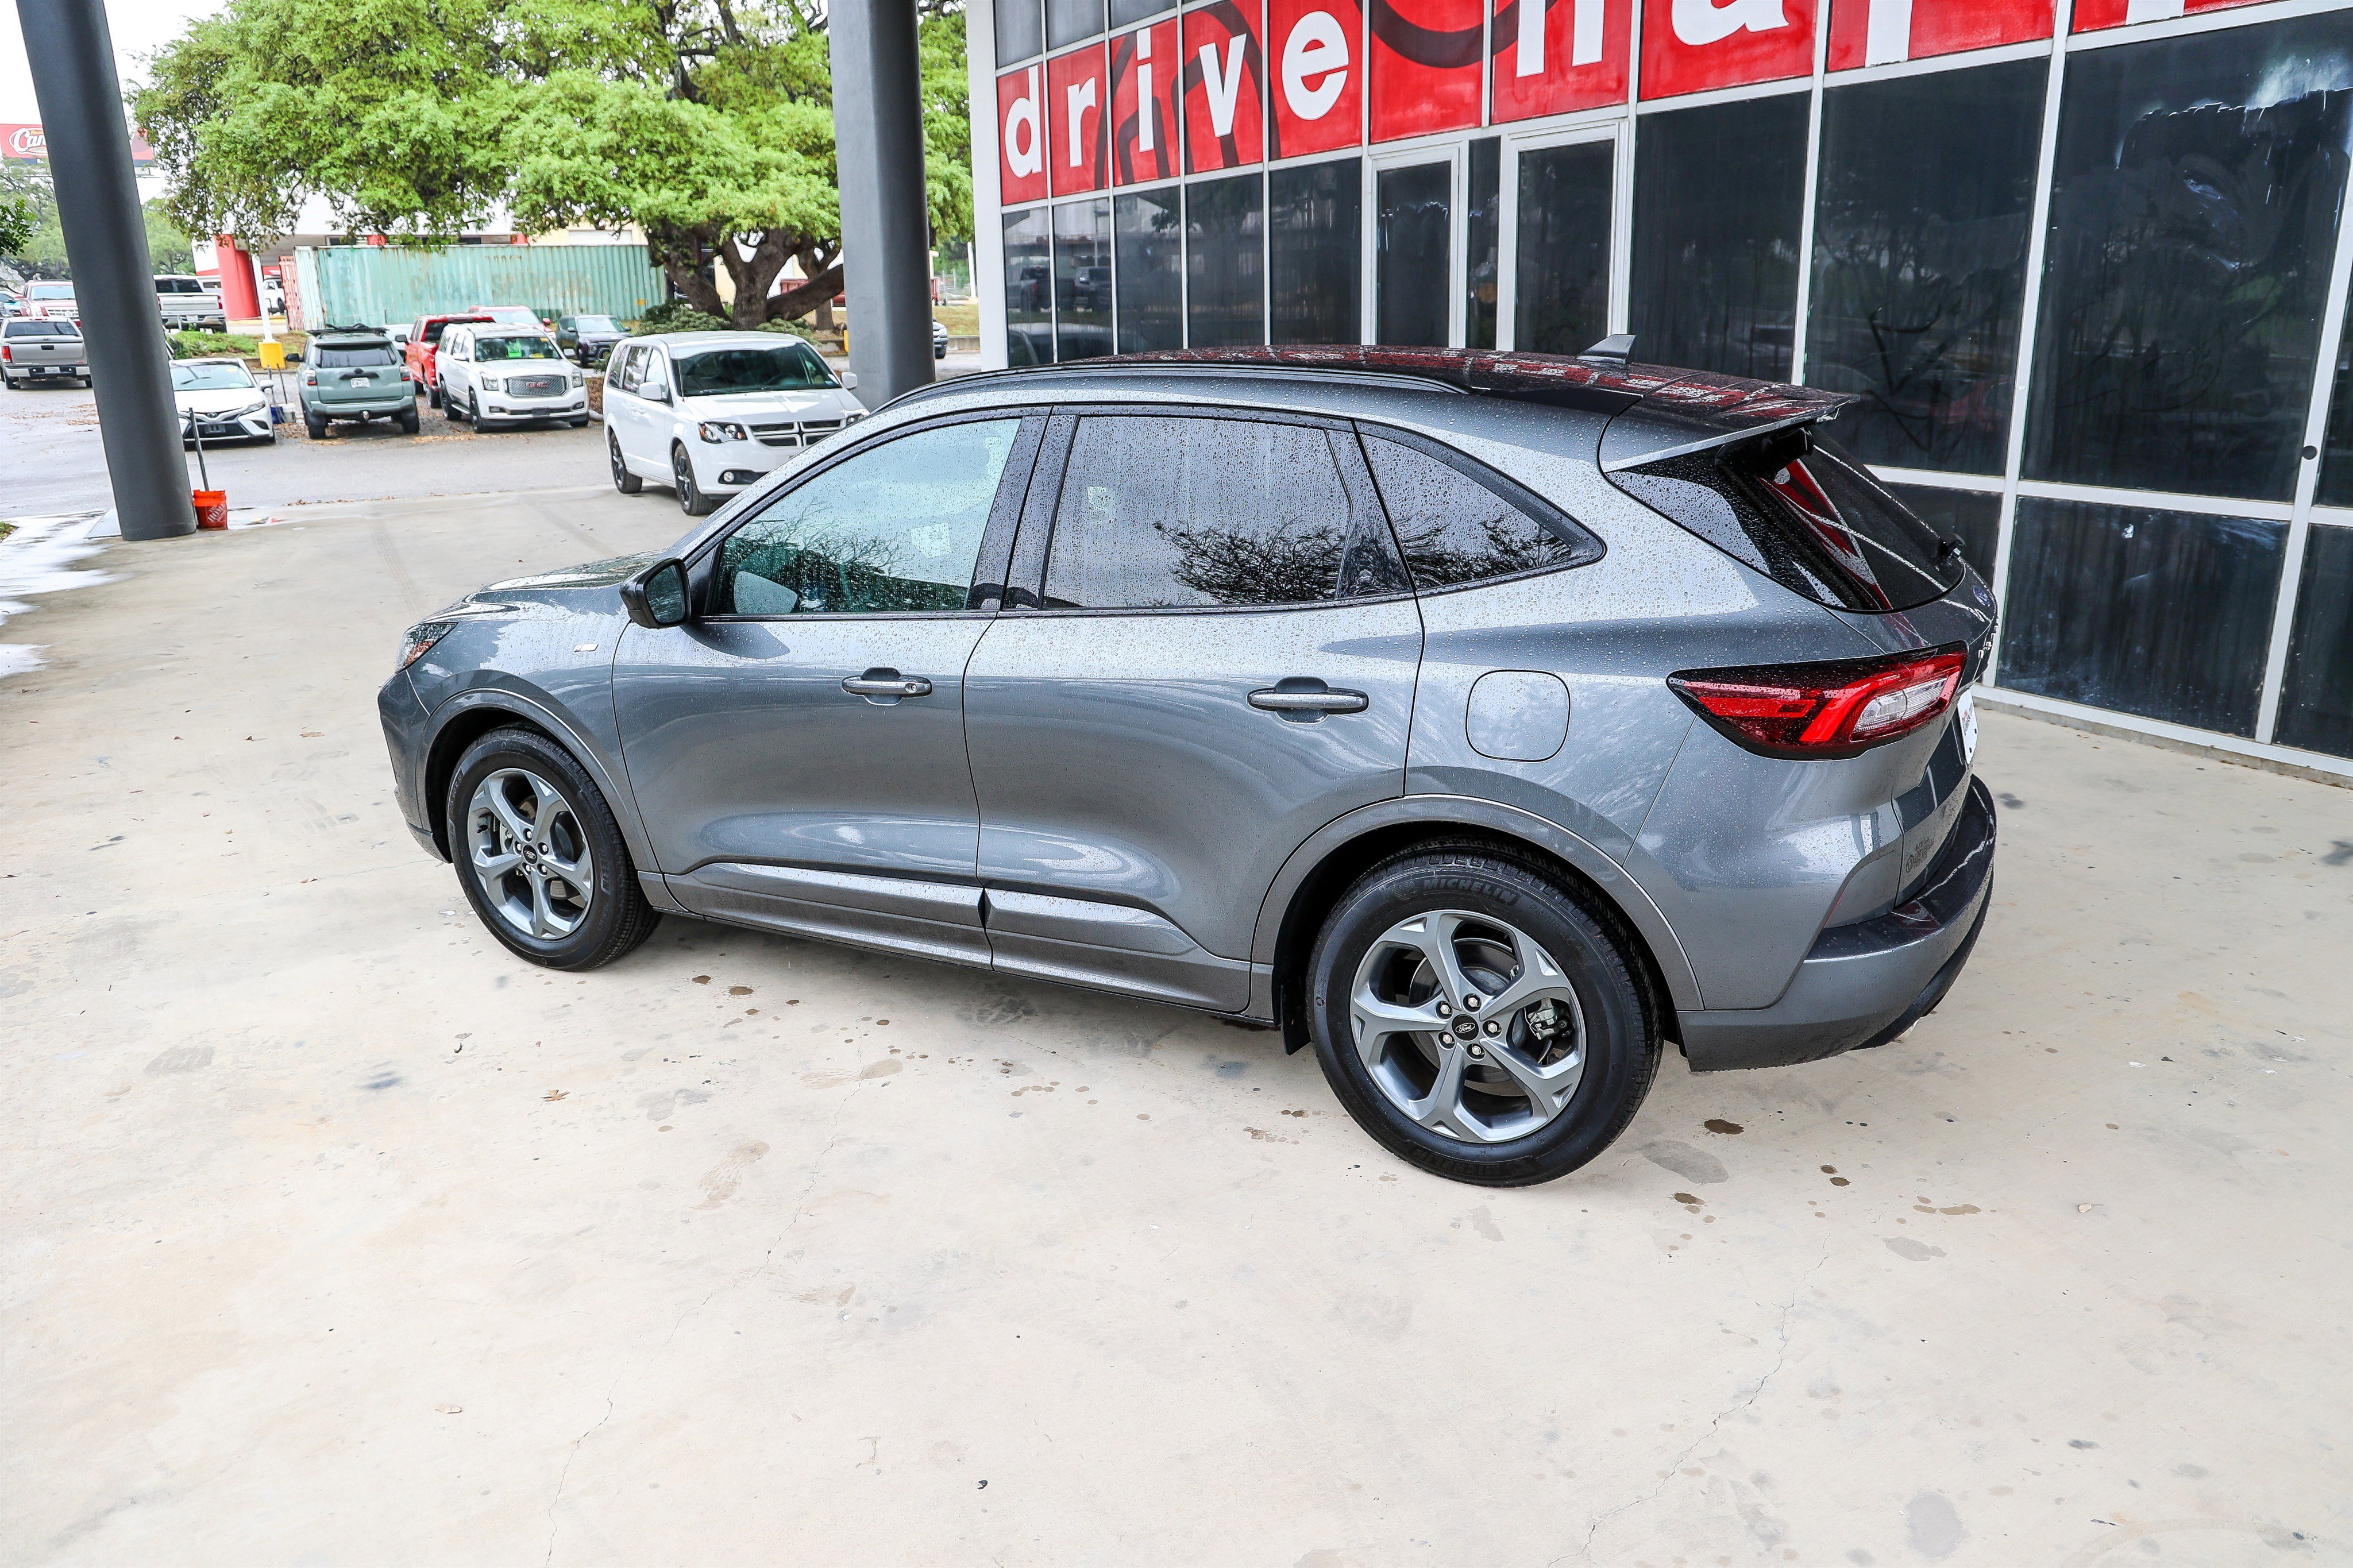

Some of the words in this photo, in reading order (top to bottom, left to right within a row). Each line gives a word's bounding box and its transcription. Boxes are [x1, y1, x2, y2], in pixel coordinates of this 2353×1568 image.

[1004, 10, 1349, 179] drive
[13, 128, 47, 152] Can
[1423, 878, 1518, 905] MICHELIN
